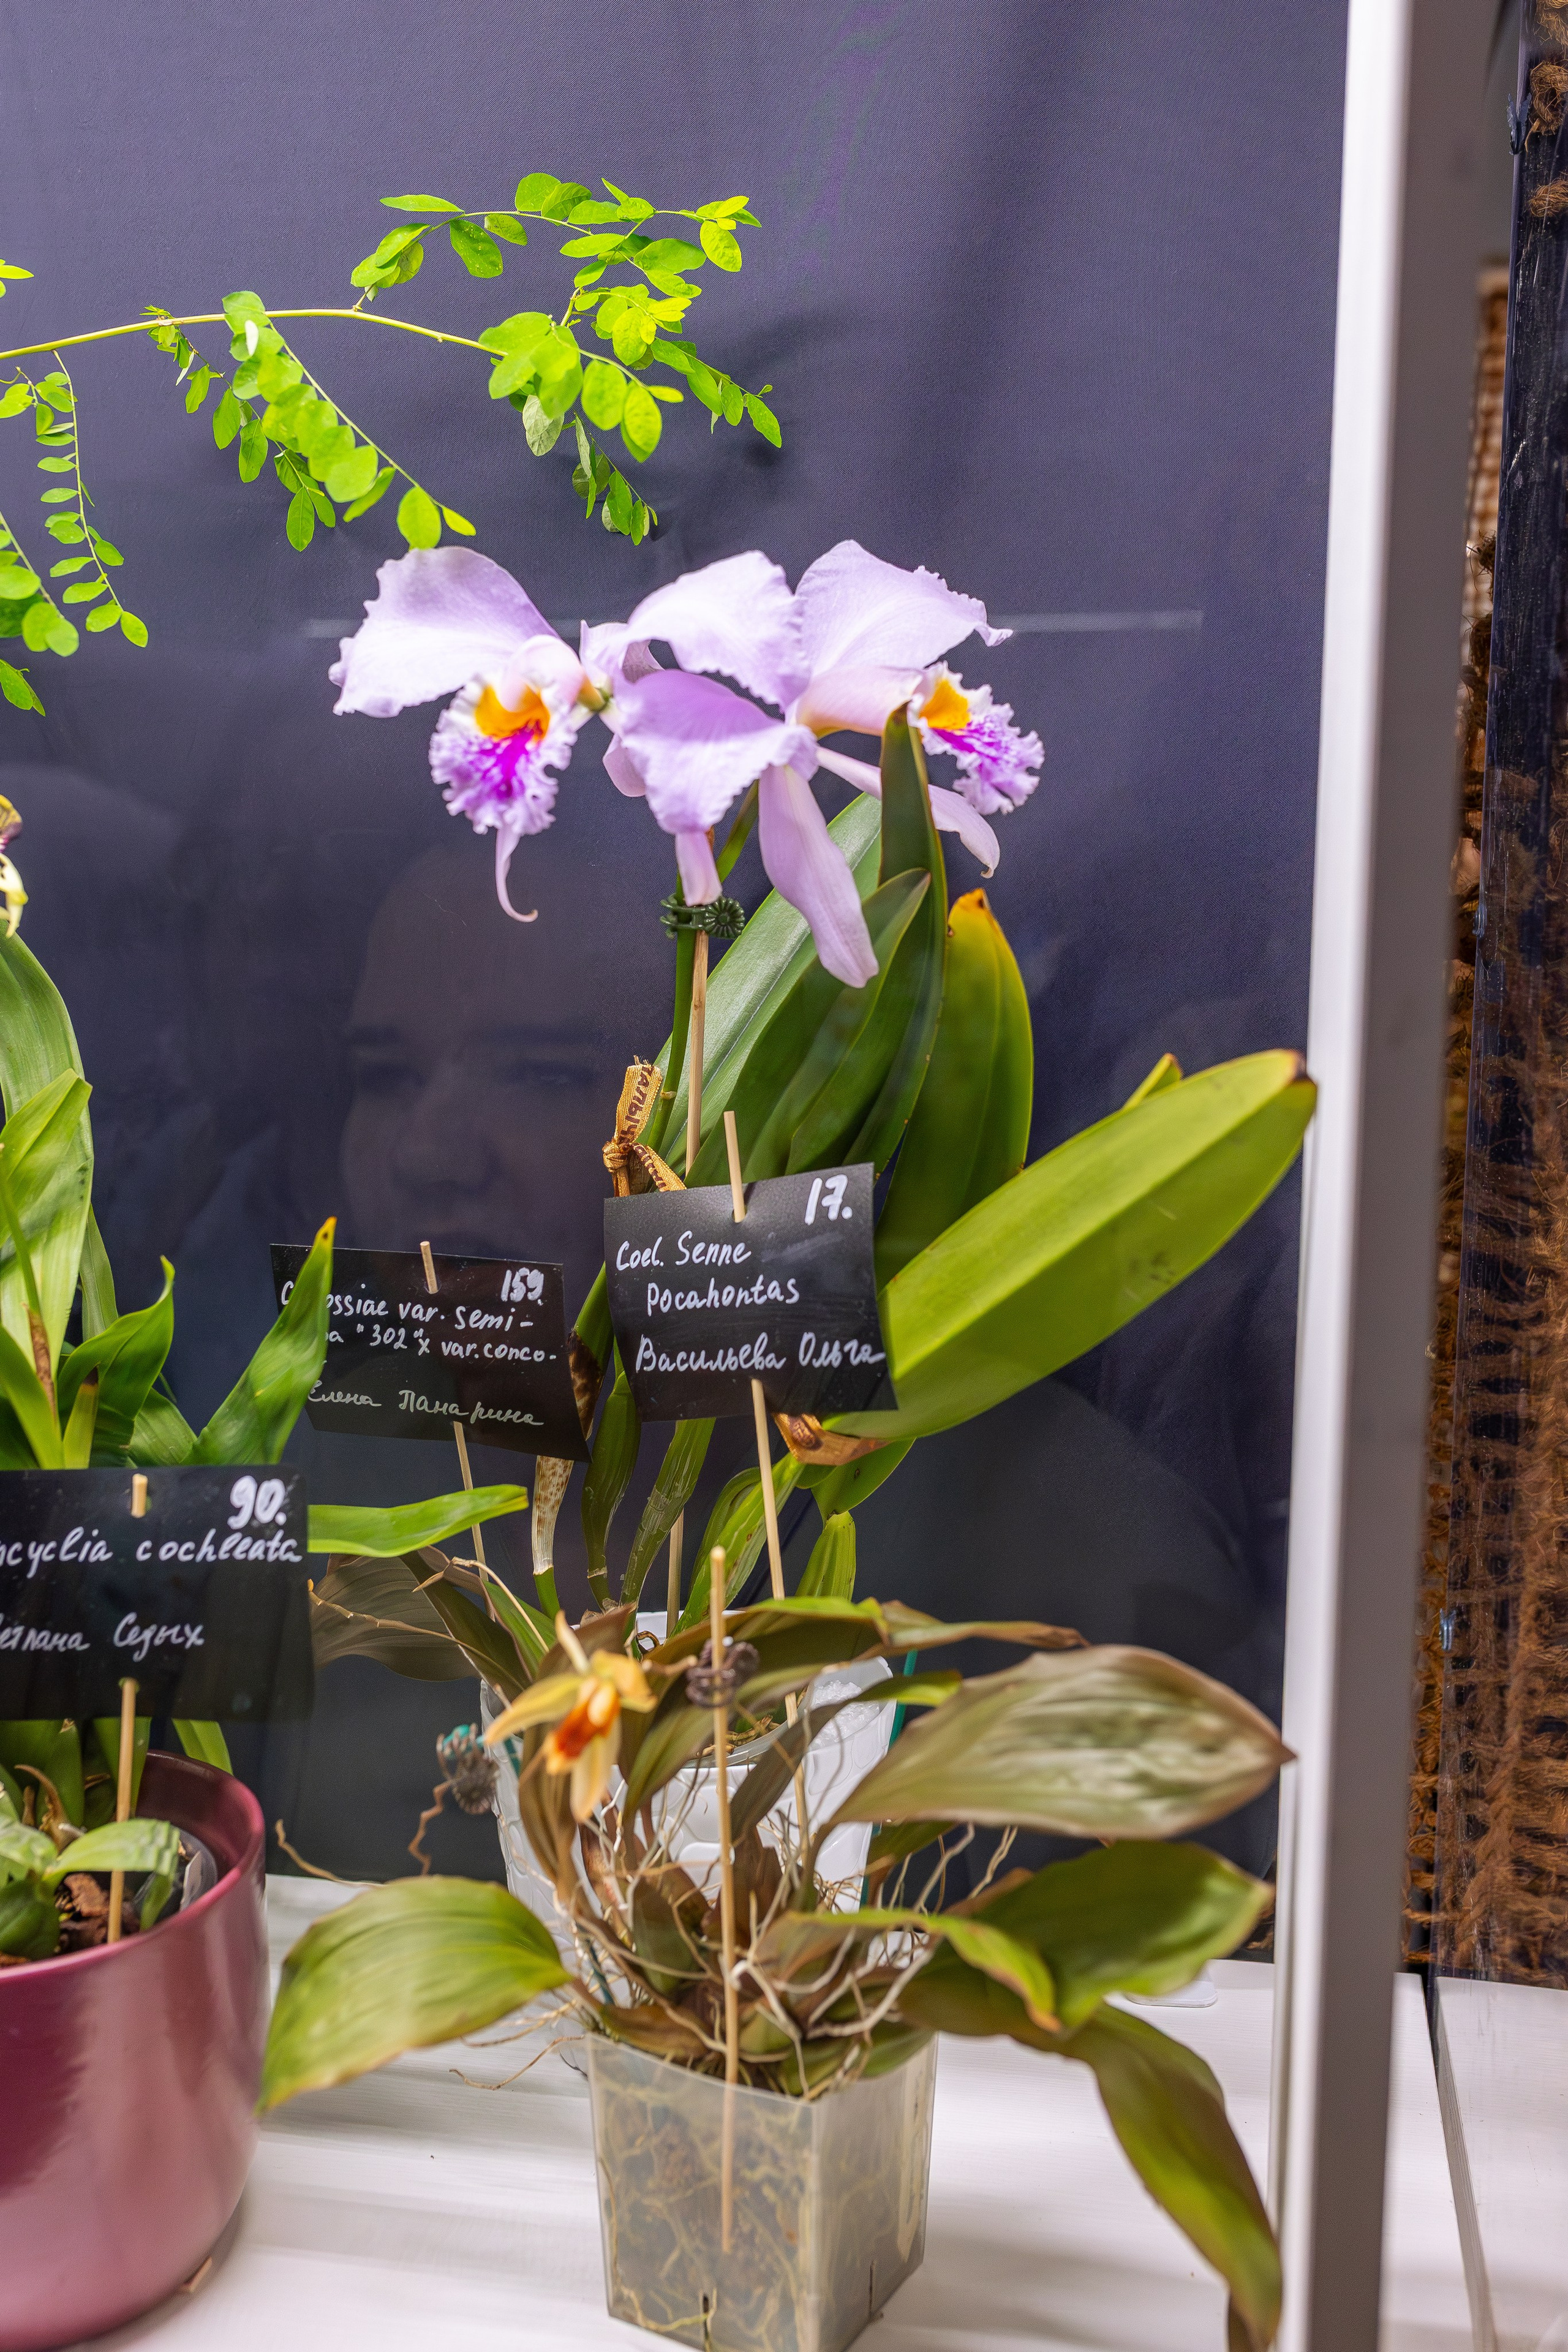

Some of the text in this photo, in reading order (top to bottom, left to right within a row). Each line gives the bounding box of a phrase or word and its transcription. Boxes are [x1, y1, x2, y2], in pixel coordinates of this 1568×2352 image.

[804, 1174, 853, 1225] 17.
[616, 1230, 752, 1271] Coel. Senne
[399, 1300, 445, 1322] var.
[647, 1275, 800, 1316] Pocahontas
[799, 1332, 886, 1368] Ольга
[227, 1475, 287, 1529] 90.
